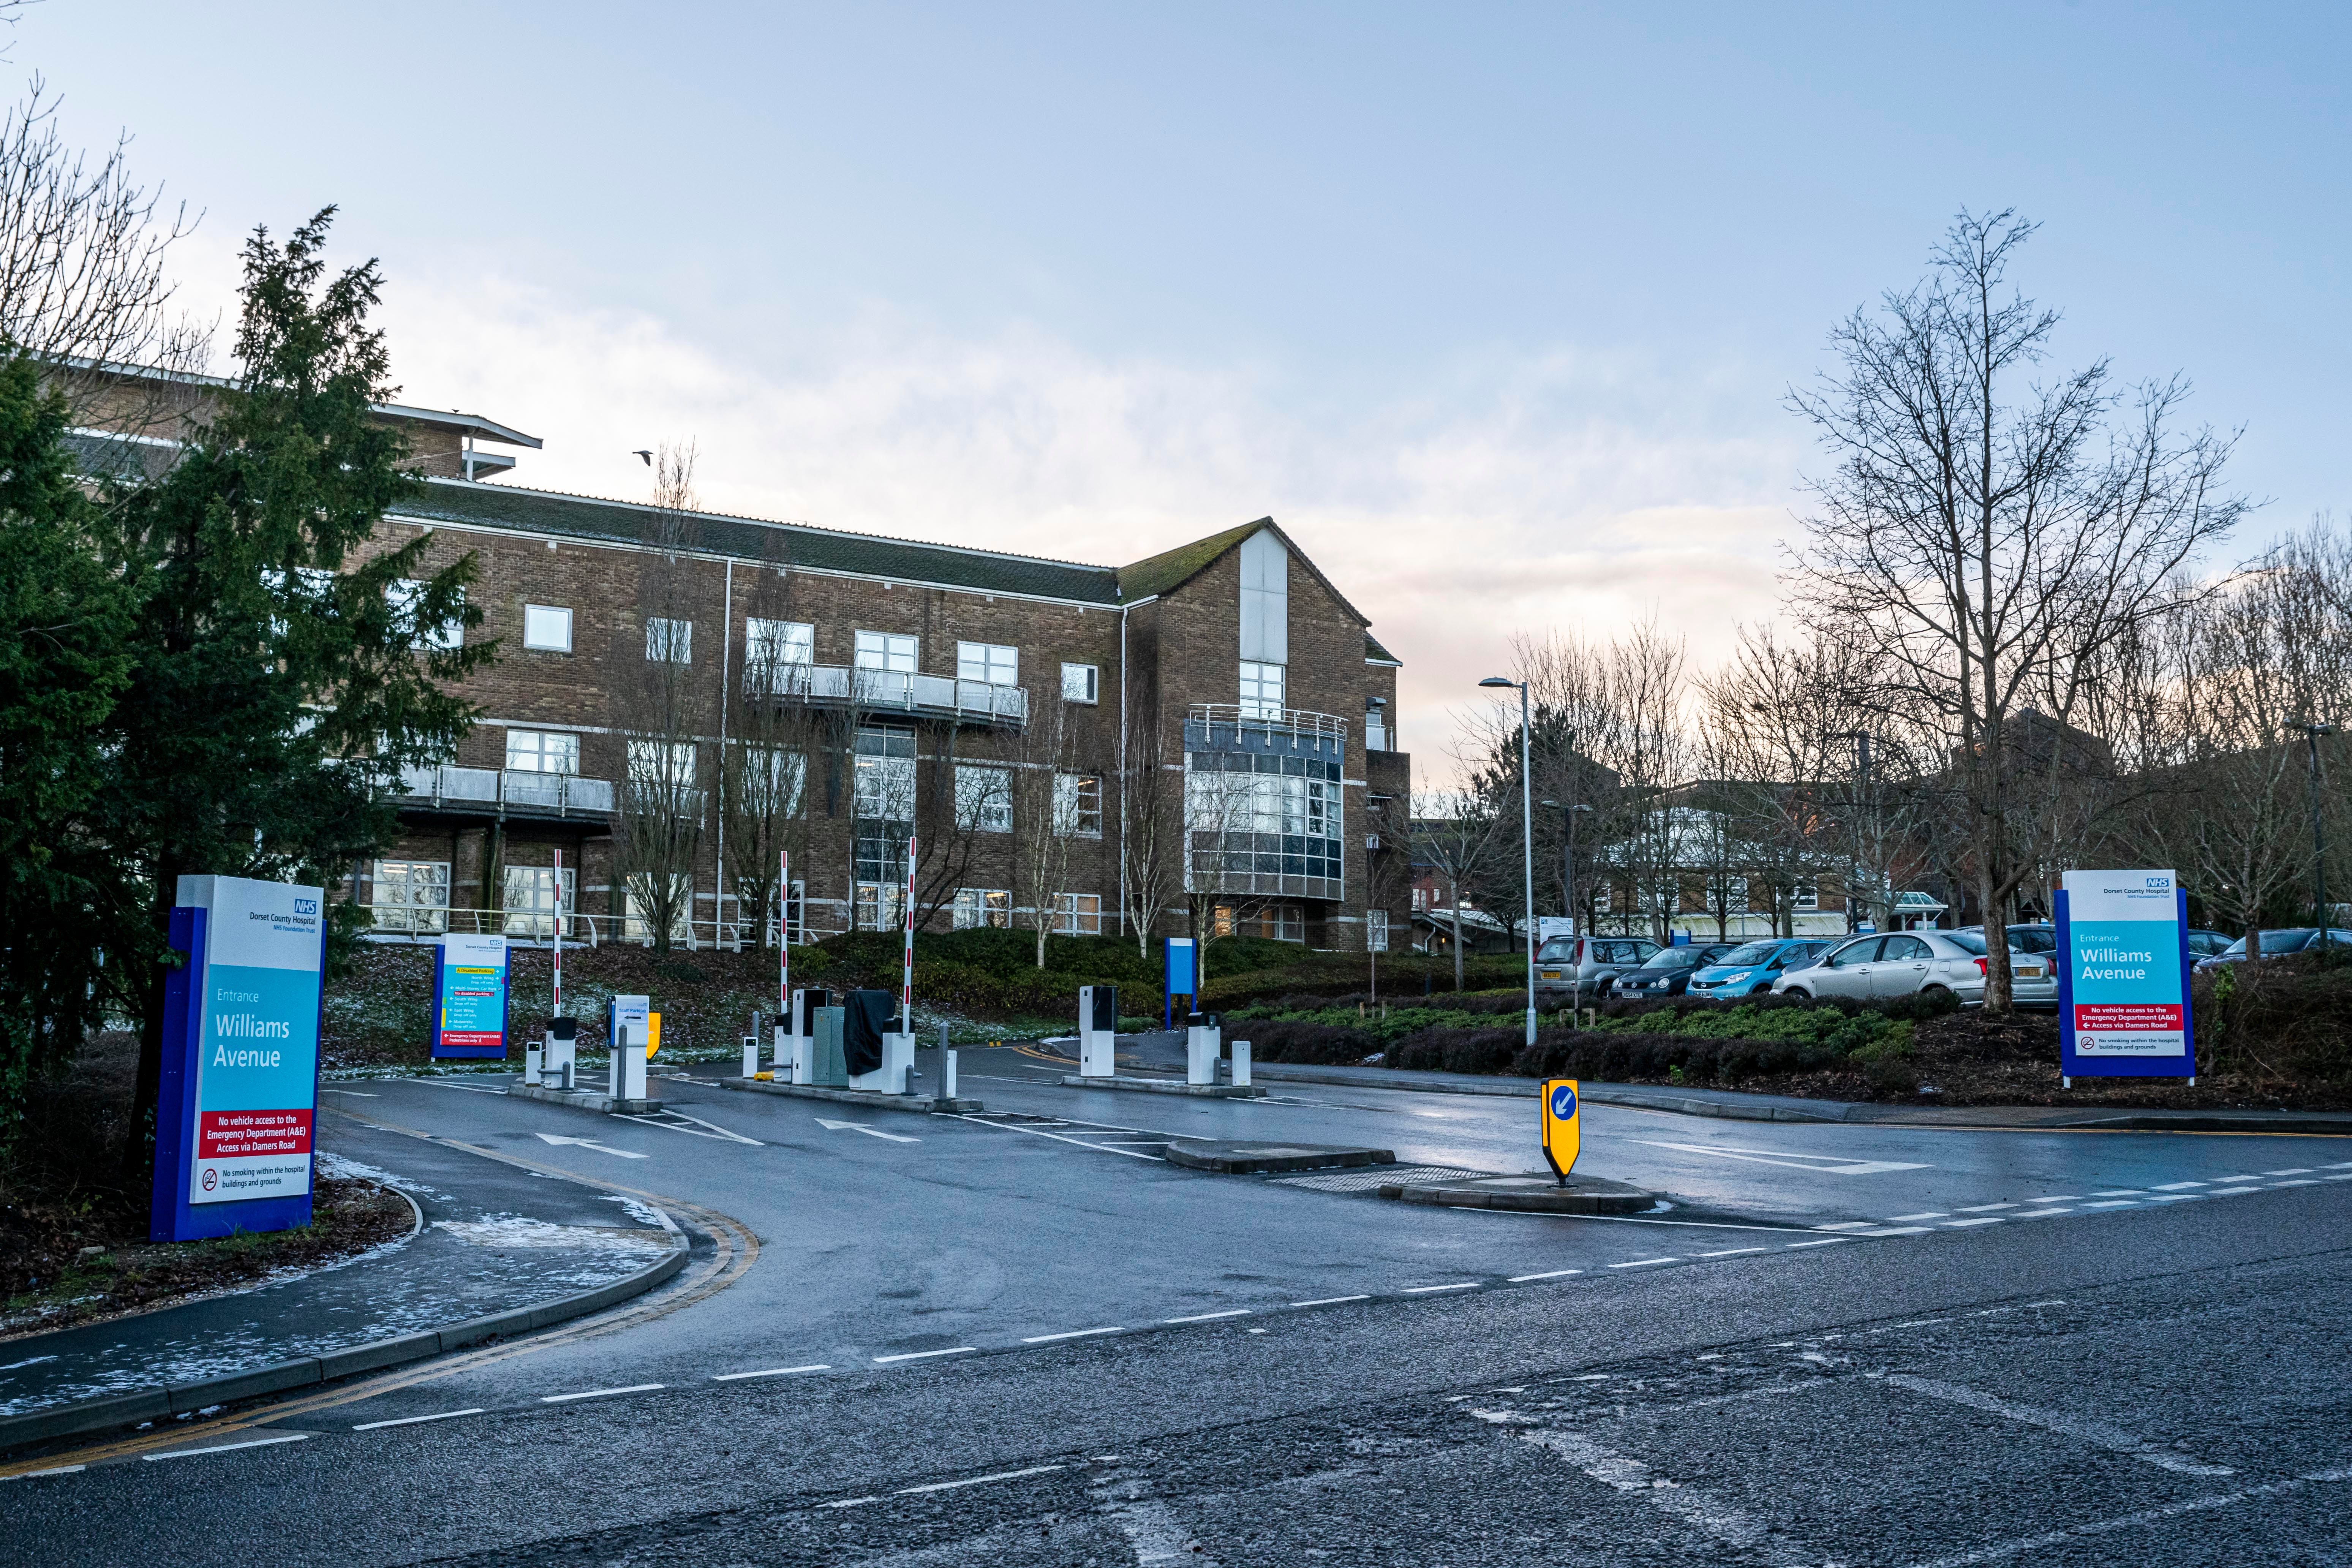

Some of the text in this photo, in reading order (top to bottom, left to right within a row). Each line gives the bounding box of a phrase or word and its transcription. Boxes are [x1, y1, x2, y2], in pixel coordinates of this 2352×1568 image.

[296, 900, 316, 913] NHS
[250, 912, 316, 926] Dorset County Hospital
[2080, 948, 2152, 962] Williams
[2082, 966, 2145, 979] Avenue
[218, 988, 259, 1002] Entrance
[216, 1014, 289, 1038] Williams
[213, 1045, 280, 1067] Avenue
[218, 1117, 228, 1125] No
[230, 1116, 253, 1125] vehicle
[286, 1114, 296, 1123] the
[207, 1126, 306, 1141] Emergency Department (A&E)
[217, 1140, 296, 1152] Access via Damers Road
[232, 1168, 255, 1177] smoking
[285, 1165, 305, 1174] hospital
[222, 1180, 247, 1189] buildings
[260, 1177, 281, 1187] grounds
